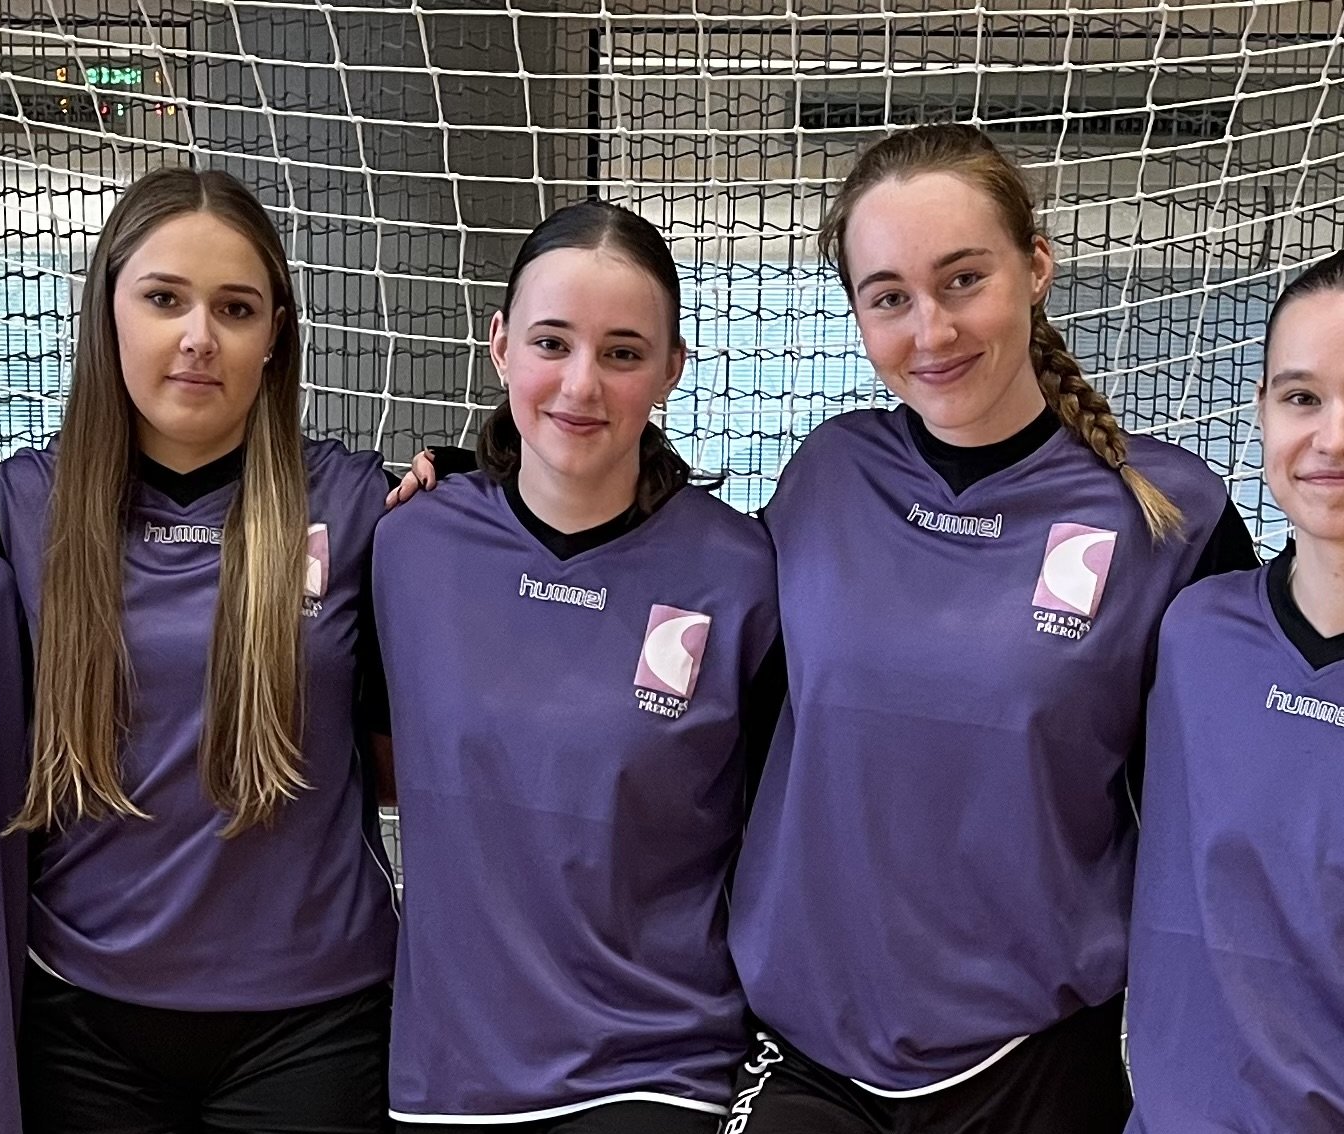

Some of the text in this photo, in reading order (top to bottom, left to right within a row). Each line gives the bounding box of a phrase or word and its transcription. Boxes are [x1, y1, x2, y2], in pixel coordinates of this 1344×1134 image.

[144, 522, 223, 544] humme
[906, 503, 1003, 538] hummel
[519, 573, 607, 610] hummel
